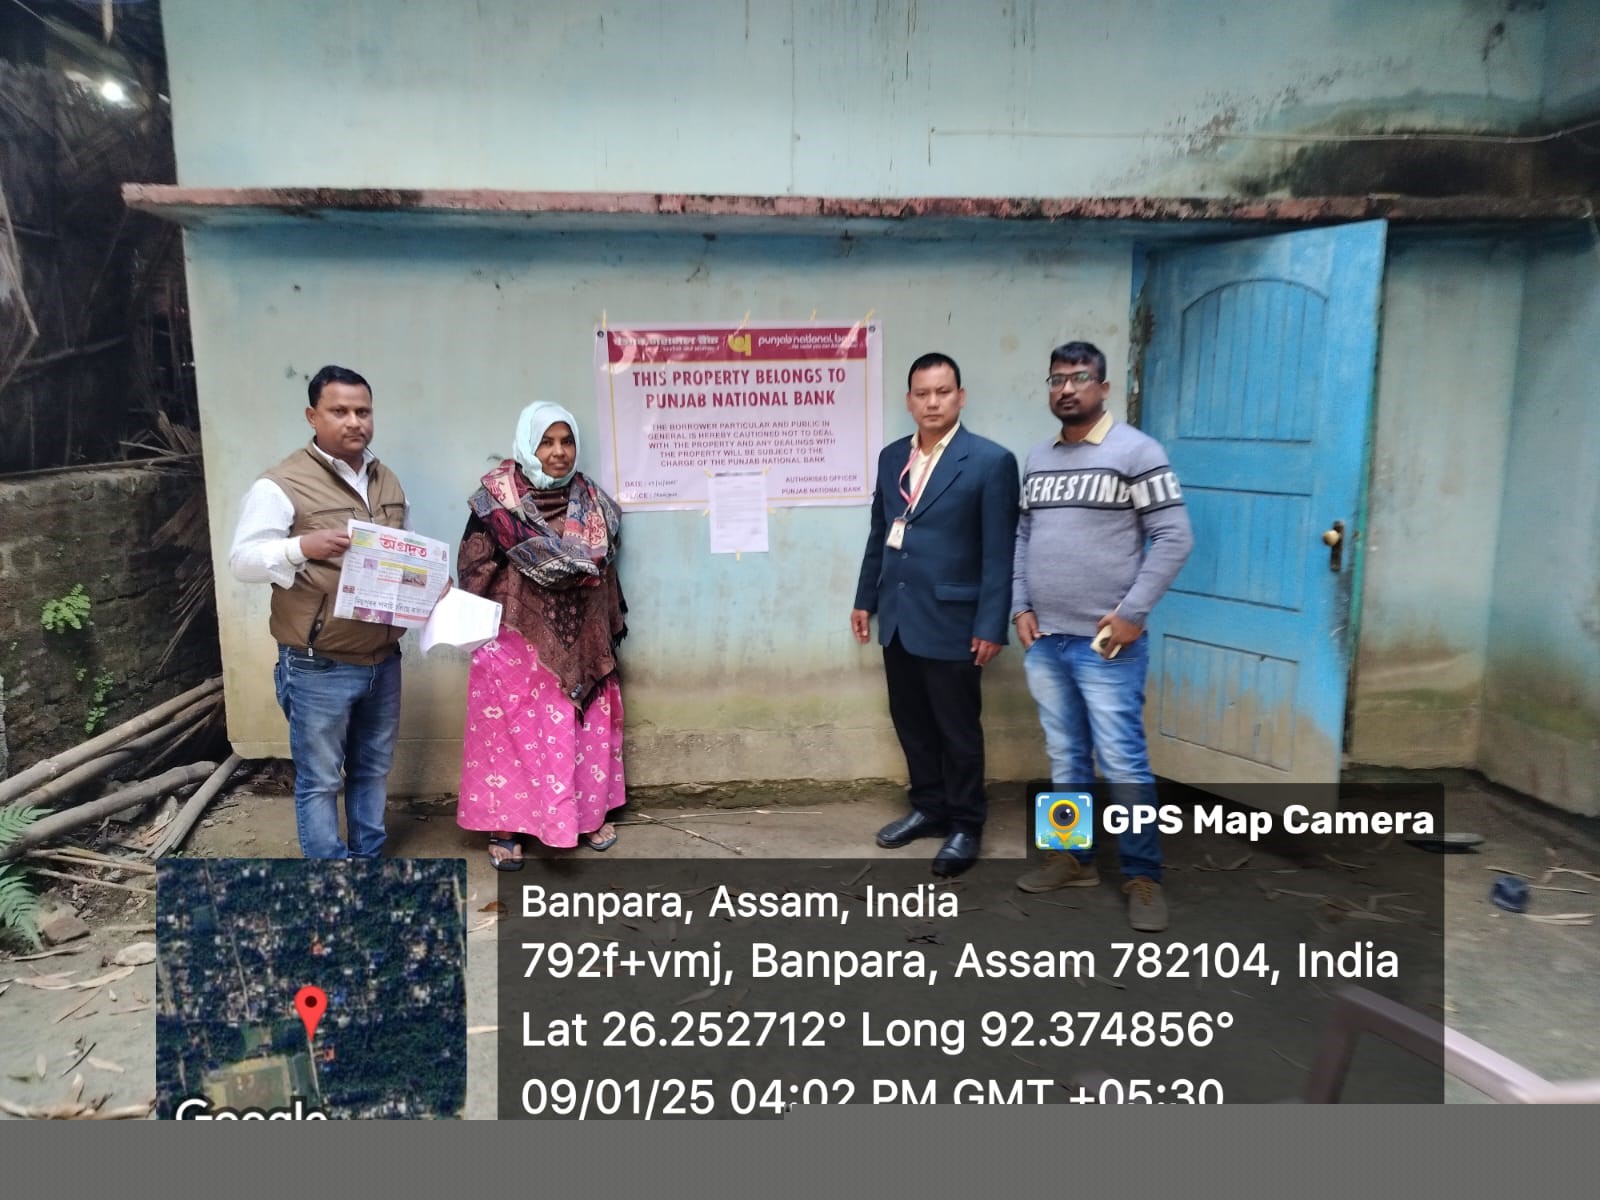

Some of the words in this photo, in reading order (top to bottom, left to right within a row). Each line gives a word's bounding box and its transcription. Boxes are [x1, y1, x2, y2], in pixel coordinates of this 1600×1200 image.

[758, 333, 792, 348] punjab
[793, 332, 833, 345] national
[633, 371, 667, 387] THIS
[673, 369, 750, 386] PROPERTY
[756, 368, 822, 385] BELONGS
[827, 367, 846, 383] TO
[646, 393, 706, 409] PUNJAB
[712, 391, 788, 408] NATIONAL
[794, 390, 835, 406] BANK
[670, 422, 717, 431] BORROWER
[720, 421, 769, 430] PARTICULAR
[772, 420, 789, 428] AND
[792, 419, 820, 428] PUBLIC
[648, 431, 686, 440] GENERAL
[689, 431, 696, 439] IS
[699, 430, 731, 439] HEREBY
[733, 430, 780, 439] CAUTIONED
[782, 430, 798, 438] NOT
[801, 429, 811, 437] TO
[813, 428, 834, 437] DEAL
[649, 442, 669, 450] WITH
[673, 441, 689, 449] THE
[692, 440, 734, 449] PROPERTY
[756, 439, 772, 447] ANY
[774, 438, 814, 447] DEALINGS
[816, 437, 836, 445] WITH
[660, 450, 676, 459] THE
[678, 449, 721, 458] PROPERTY
[723, 449, 743, 457] WILL
[745, 449, 755, 457] BE
[758, 448, 793, 456] SUBJECT
[796, 447, 807, 455] TO
[809, 447, 824, 455] THE
[660, 459, 695, 468] CHARGE
[697, 458, 707, 467] OF
[711, 458, 726, 467] THE
[728, 457, 760, 467] PUNJAB
[762, 456, 801, 465] NATIONAL
[804, 455, 826, 464] BANK
[624, 480, 642, 488] DATE
[785, 475, 827, 484] AUTHORISED
[829, 474, 857, 482] OFFICER
[781, 487, 809, 496] PUNJAB
[810, 486, 841, 495] NATIONAL
[843, 485, 862, 494] BANK
